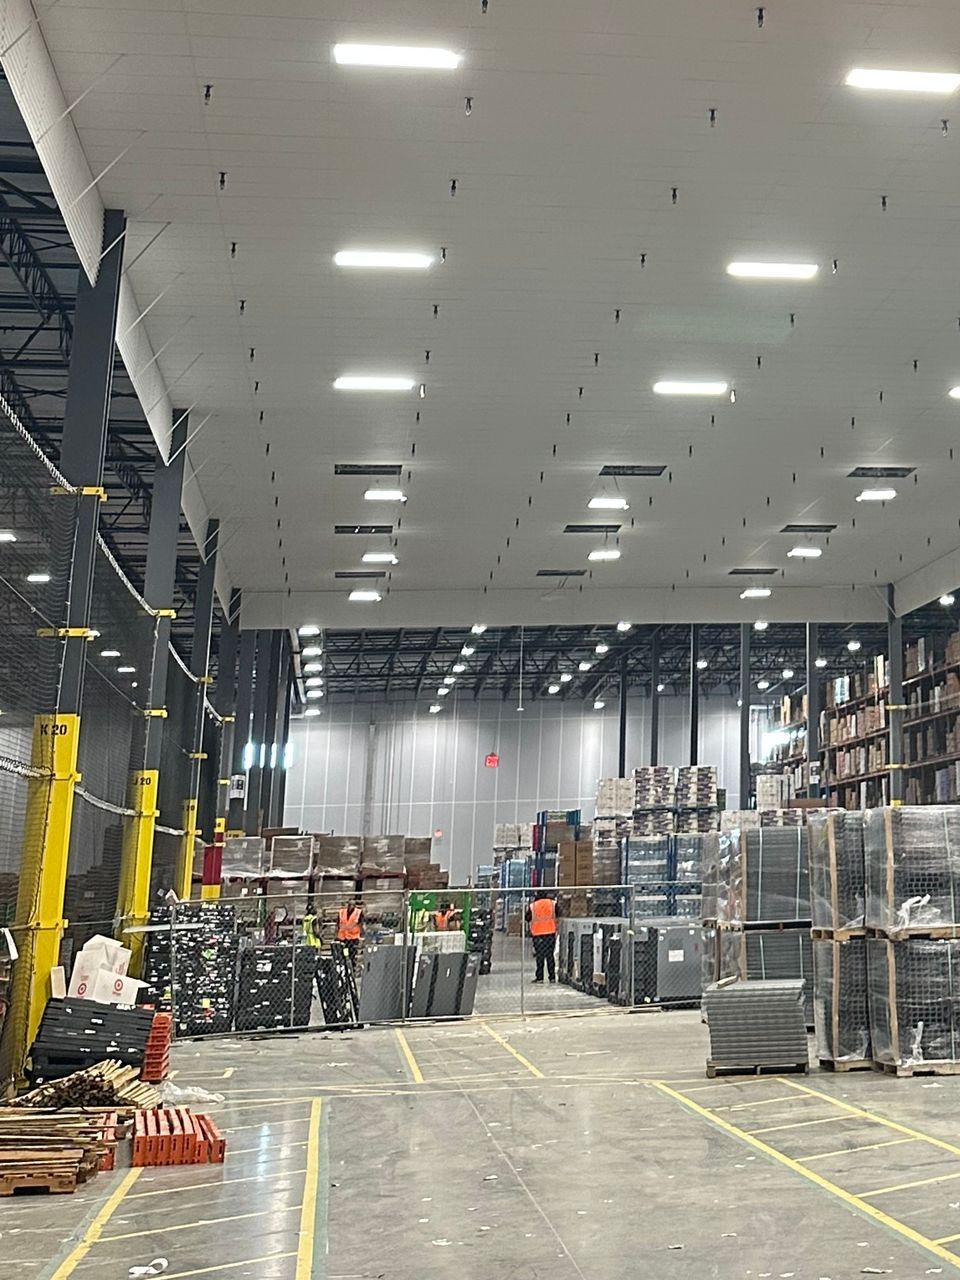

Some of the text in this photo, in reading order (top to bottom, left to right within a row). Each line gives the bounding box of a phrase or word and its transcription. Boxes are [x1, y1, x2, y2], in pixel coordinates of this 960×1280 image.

[40, 724, 67, 735] K 20
[140, 777, 151, 785] 20
